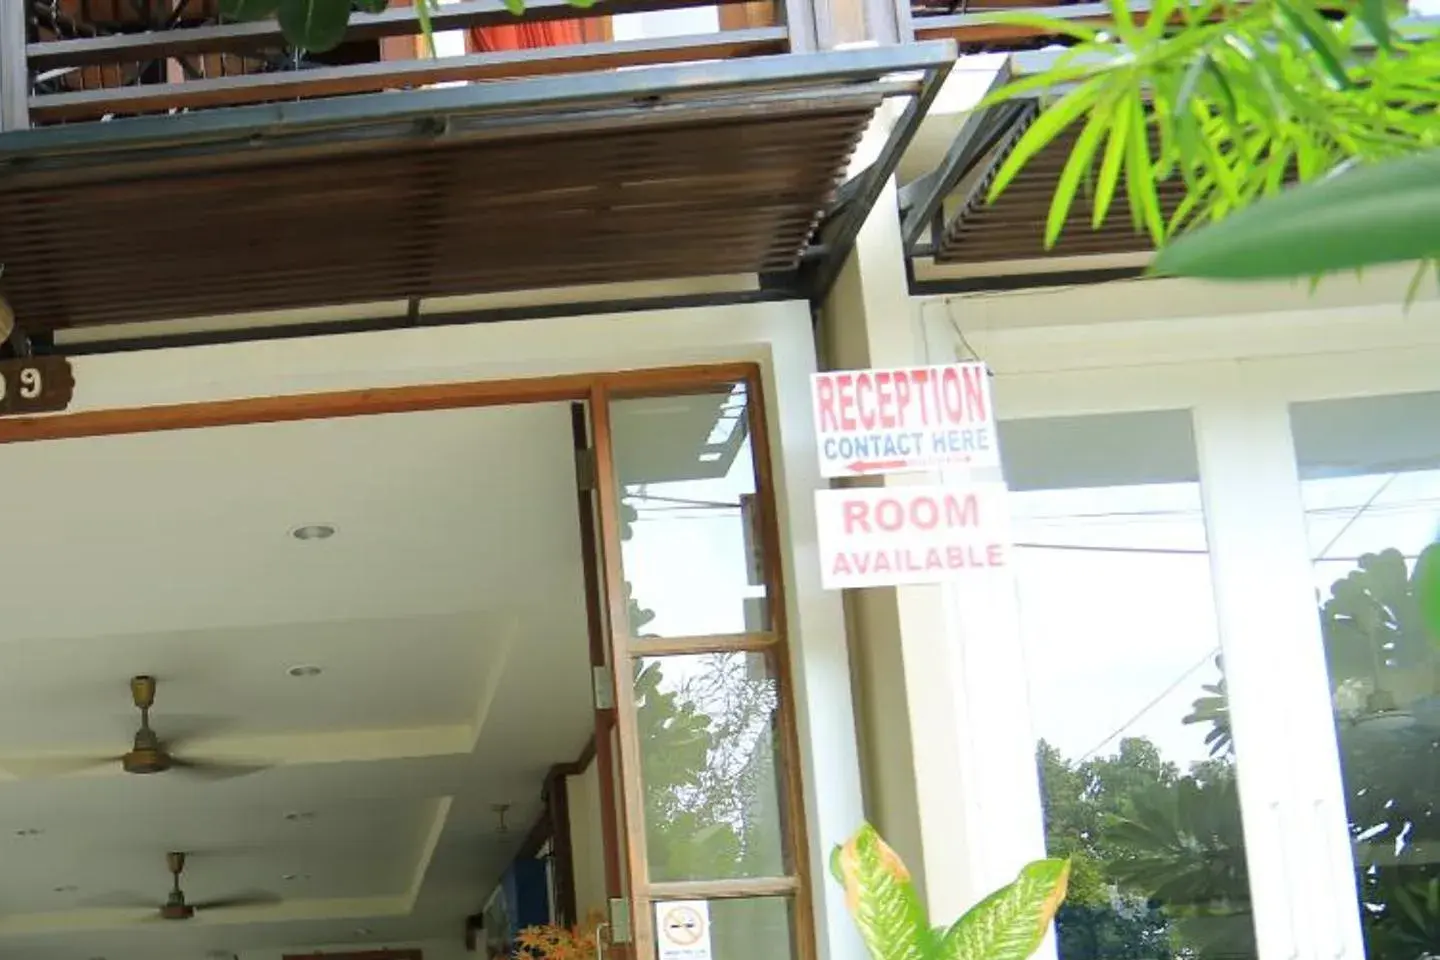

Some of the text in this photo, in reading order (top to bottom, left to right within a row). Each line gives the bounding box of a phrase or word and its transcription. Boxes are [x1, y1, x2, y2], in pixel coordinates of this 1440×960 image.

[816, 366, 987, 433] RECEPTION
[824, 428, 989, 461] CONTACT HERE
[842, 494, 980, 535] ROOM
[832, 543, 1006, 577] AVAILABLE
